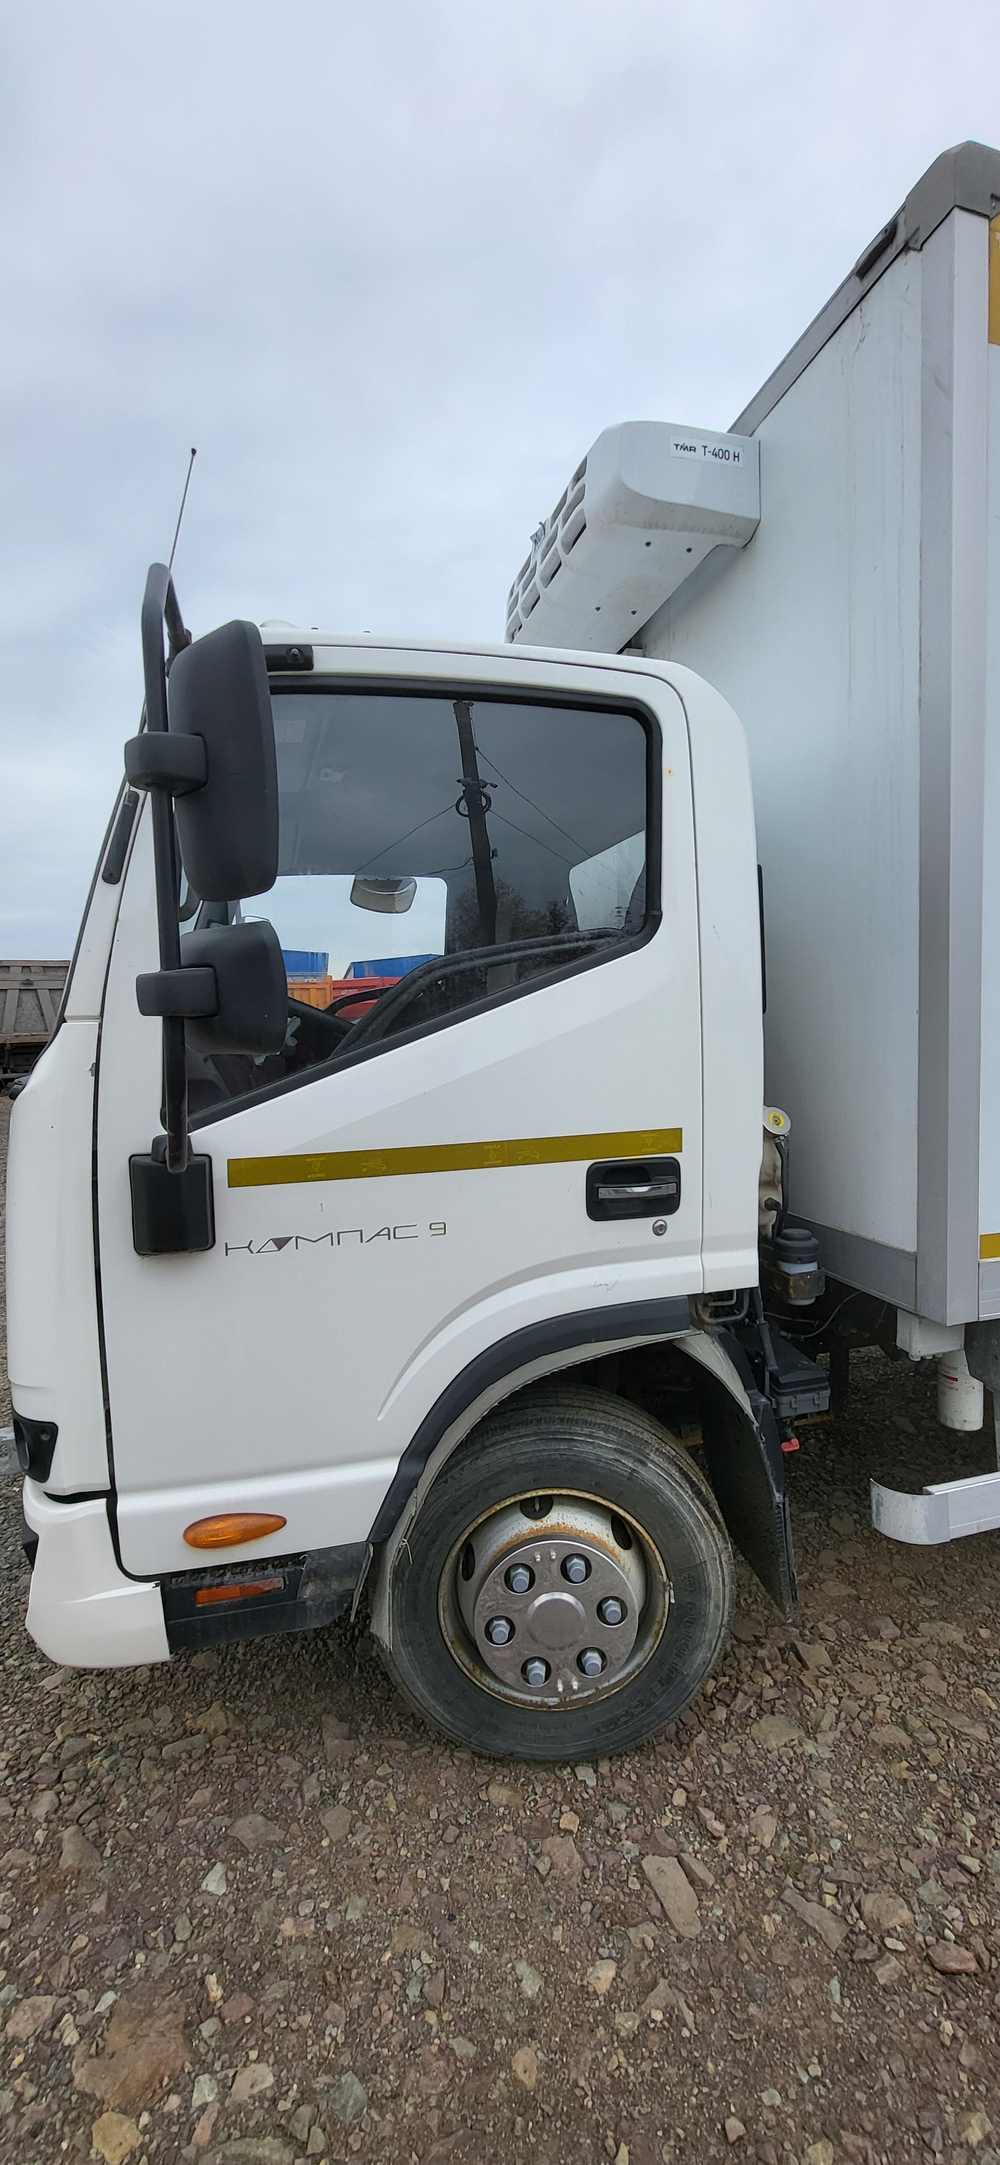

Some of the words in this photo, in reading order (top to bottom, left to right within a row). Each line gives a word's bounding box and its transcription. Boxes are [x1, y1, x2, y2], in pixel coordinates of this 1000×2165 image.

[702, 445, 731, 461] T-400
[733, 451, 740, 463] H
[429, 1221, 447, 1237] 9
